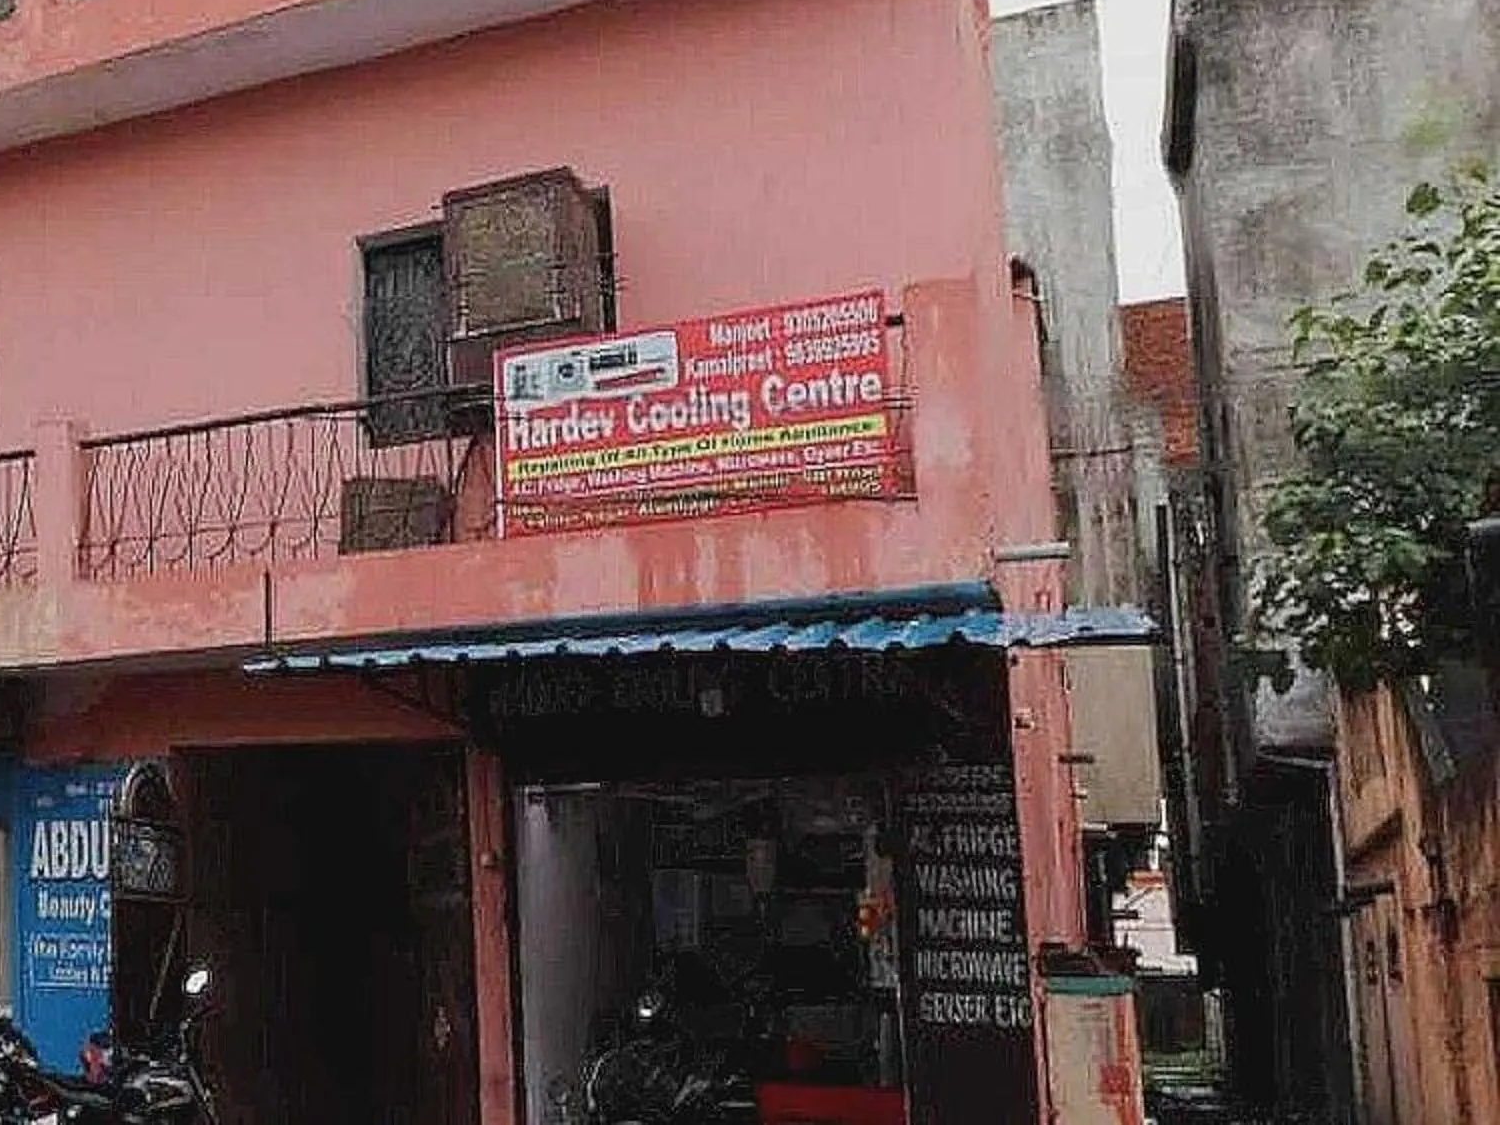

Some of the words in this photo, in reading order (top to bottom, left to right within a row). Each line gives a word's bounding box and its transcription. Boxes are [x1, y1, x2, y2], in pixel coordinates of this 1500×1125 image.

[628, 388, 750, 431] Cooling
[762, 372, 882, 414] Centre
[31, 820, 109, 879] ABDU
[915, 863, 1017, 900] WASHING
[917, 949, 1027, 985] MICROWAVE
